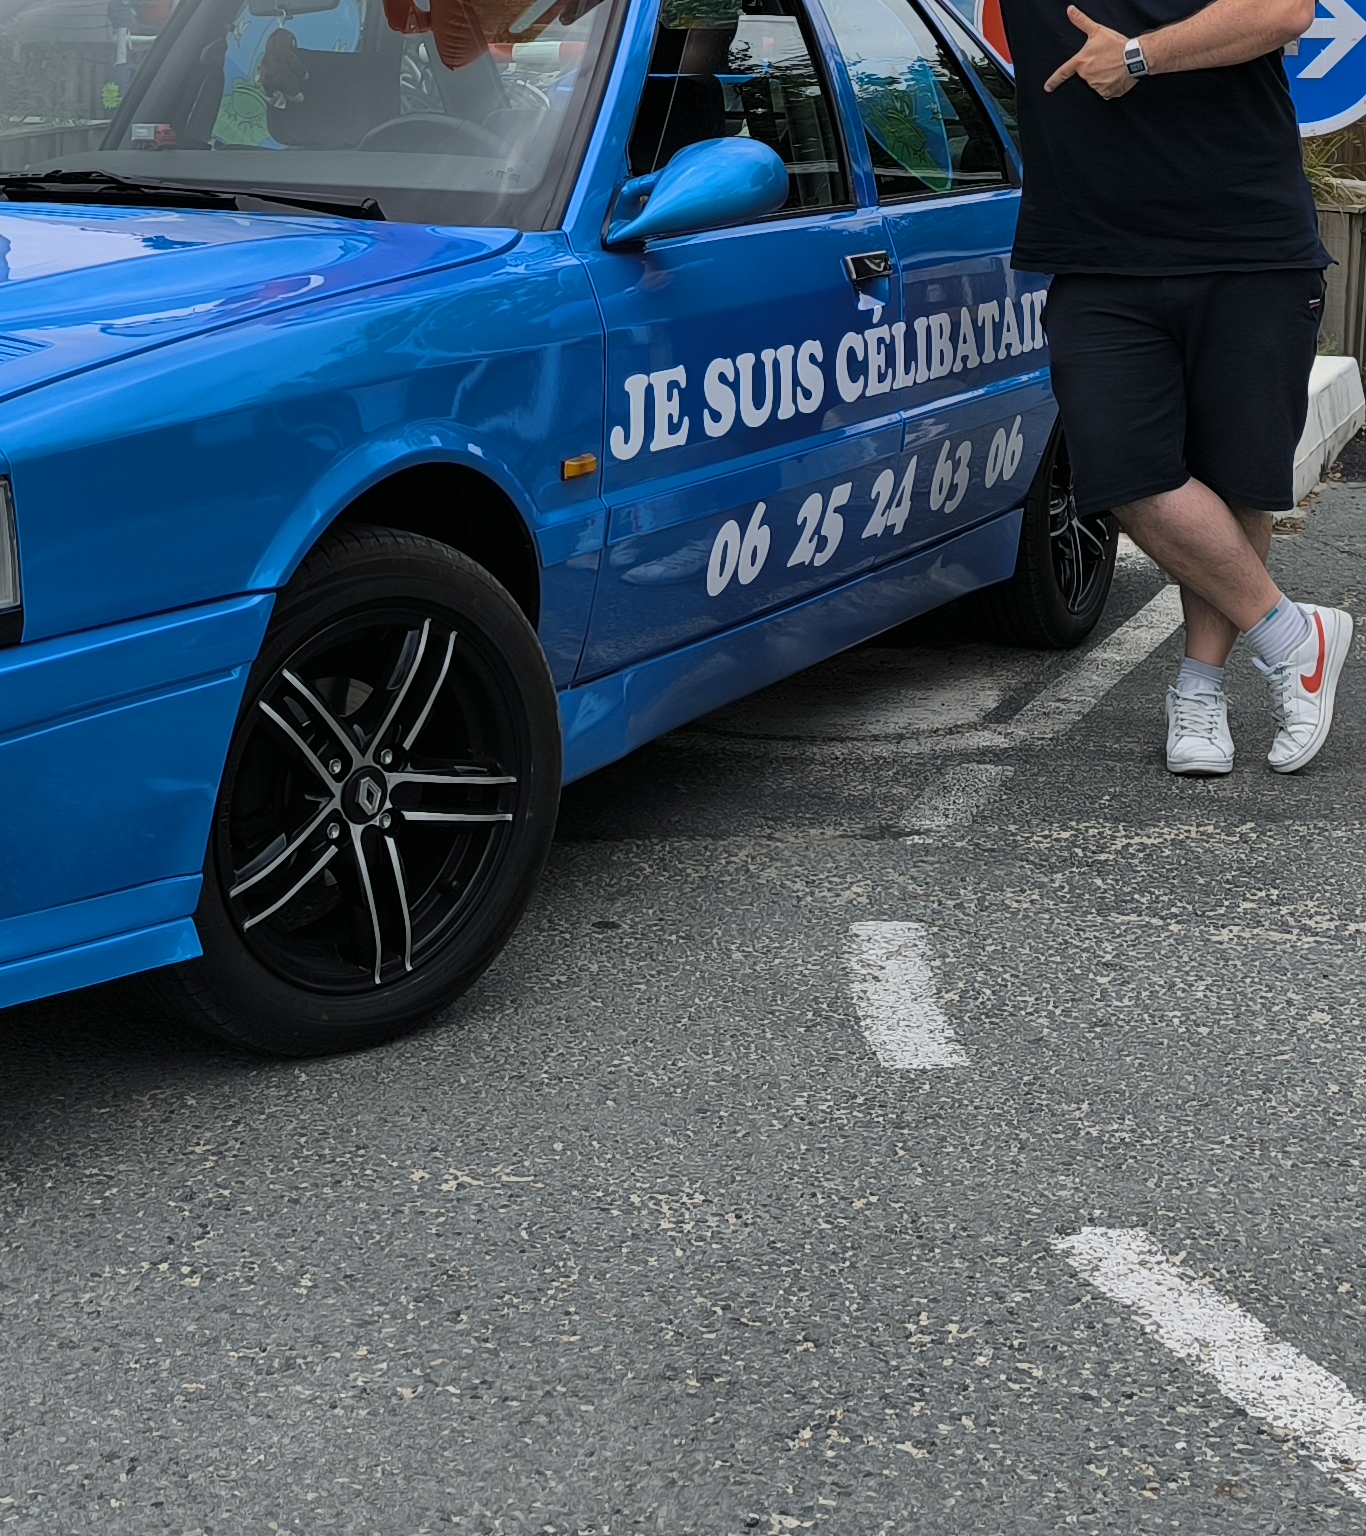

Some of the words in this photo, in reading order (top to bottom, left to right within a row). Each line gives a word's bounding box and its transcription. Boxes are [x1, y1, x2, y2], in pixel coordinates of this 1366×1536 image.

[610, 364, 689, 460] JE
[703, 339, 825, 437] SUIS
[707, 501, 771, 596] 06
[786, 481, 852, 567] 25
[861, 454, 918, 540] 24
[929, 439, 972, 514] 63
[985, 414, 1024, 489] 06
